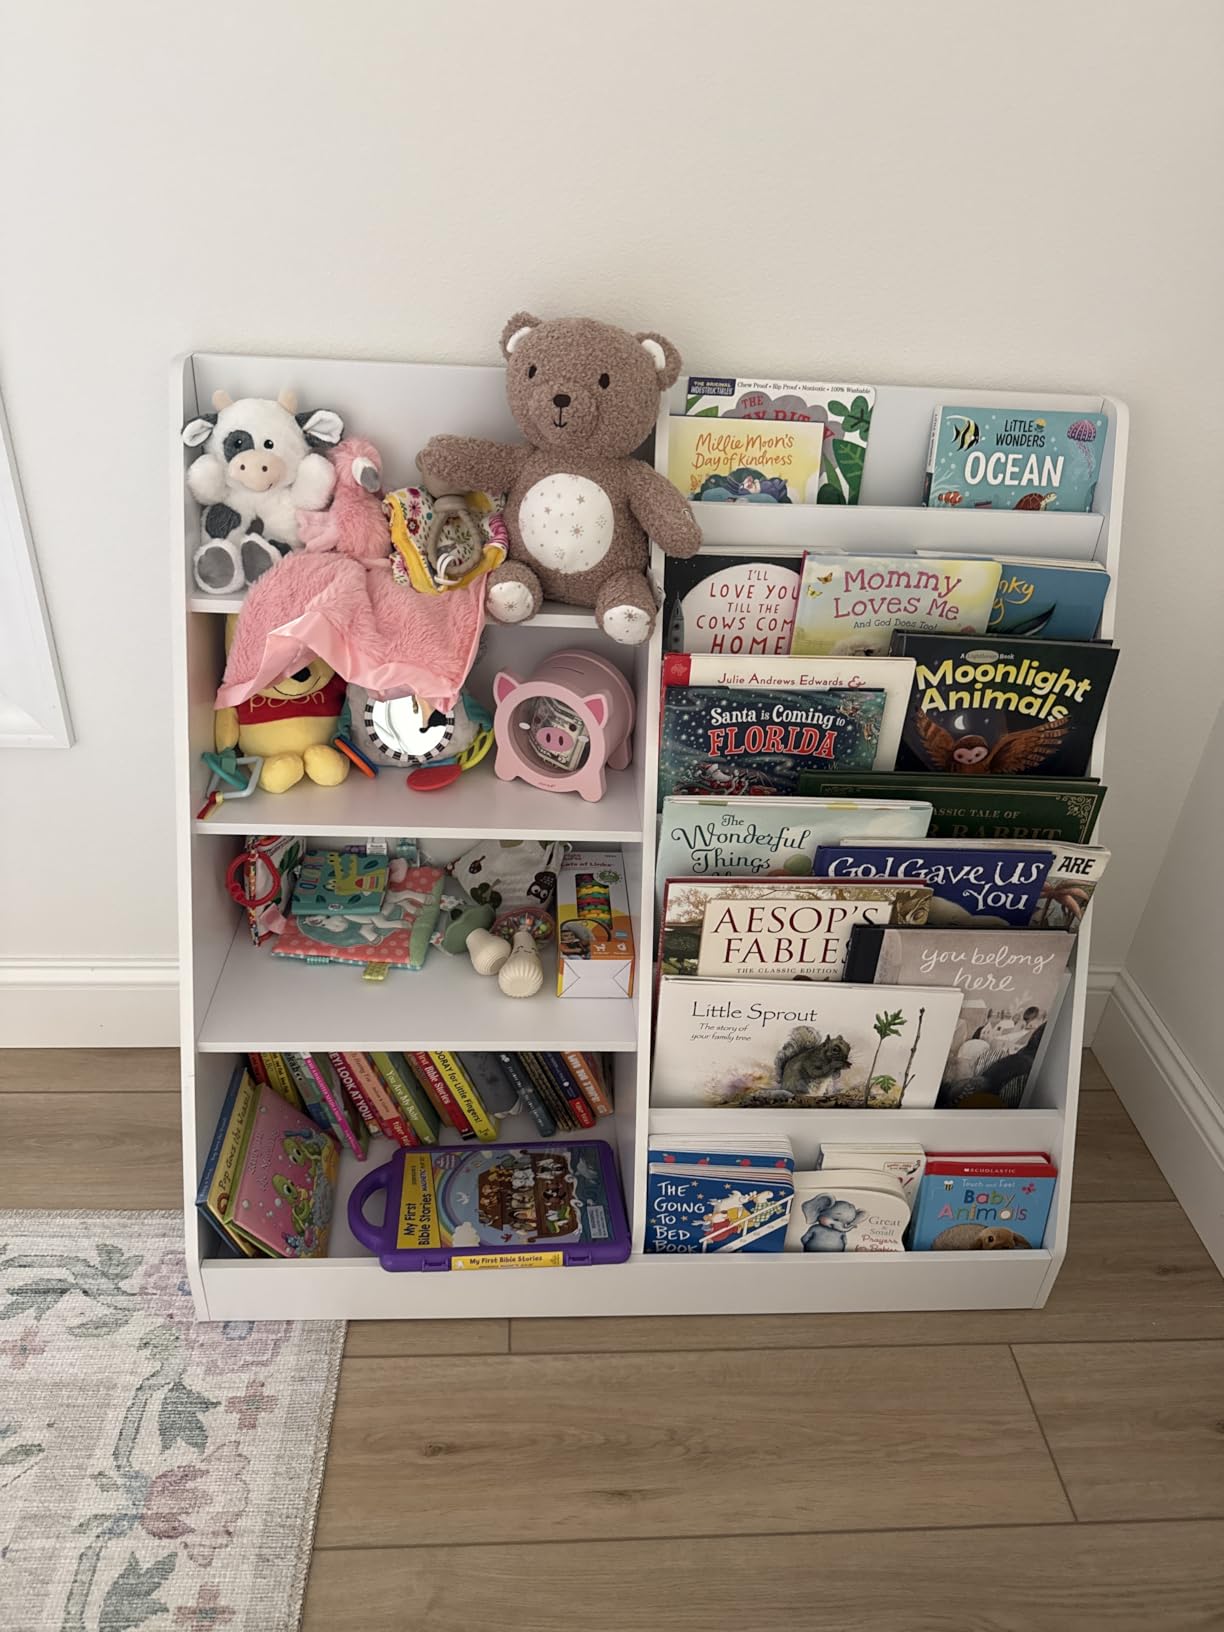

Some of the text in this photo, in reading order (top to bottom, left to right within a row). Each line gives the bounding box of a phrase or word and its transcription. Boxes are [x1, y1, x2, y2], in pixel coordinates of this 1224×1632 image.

[741, 396, 764, 409] THE
[696, 433, 794, 454] Millie Moon's
[996, 434, 1046, 448] WONDERS
[692, 450, 793, 471] Day of Kindness
[964, 451, 1064, 487] OCEAN
[710, 582, 755, 598] LOVE
[844, 569, 962, 598] Mommy
[727, 602, 780, 614] TILL THE
[834, 597, 960, 621] Loves Me
[696, 615, 794, 633] COWS COM
[854, 619, 871, 629] And
[874, 618, 892, 626] God
[894, 618, 916, 628] Does
[710, 634, 786, 655] HOME
[718, 673, 745, 684] Julie
[750, 673, 796, 686] Andrews
[800, 674, 844, 687] Edwards
[916, 659, 1092, 702] Moonlight
[920, 683, 1070, 722] Animals
[710, 704, 846, 730] Santa is Coming to
[708, 725, 838, 759] FLORIDA
[721, 814, 744, 826] The
[932, 808, 1022, 819] ASSIC TALE OF
[671, 822, 811, 852] Wonderful
[691, 846, 771, 874] Things
[1057, 856, 1096, 876] ARE
[898, 858, 986, 885] Gave
[962, 883, 1028, 911] You
[711, 905, 879, 934] AESOP'S
[722, 937, 851, 964] FABLE
[920, 945, 1055, 974] you belong
[952, 968, 1016, 992] here
[692, 1001, 818, 1028] Little Sprout
[712, 1032, 734, 1043] family
[716, 1026, 738, 1034] story
[738, 1024, 750, 1032] of
[328, 1052, 343, 1067] EY!
[336, 1064, 356, 1090] LOOK
[385, 1069, 398, 1084] You
[424, 1064, 440, 1083] Bible
[433, 1080, 452, 1105] Stories
[349, 1087, 363, 1102] AT
[447, 1070, 459, 1083] for
[453, 1081, 468, 1099] Little
[462, 1097, 482, 1125] Fingers!
[355, 1098, 374, 1121] YOU!
[657, 1180, 690, 1197] THE
[964, 1189, 1016, 1208] Baby
[654, 1197, 705, 1214] GOING
[938, 1204, 1028, 1221] Animals
[404, 1202, 418, 1236] My First
[418, 1193, 432, 1246] Bible Stories
[656, 1212, 676, 1225] TO
[868, 1216, 900, 1226] Great
[654, 1225, 690, 1241] BED
[653, 1240, 698, 1254] BOOK
